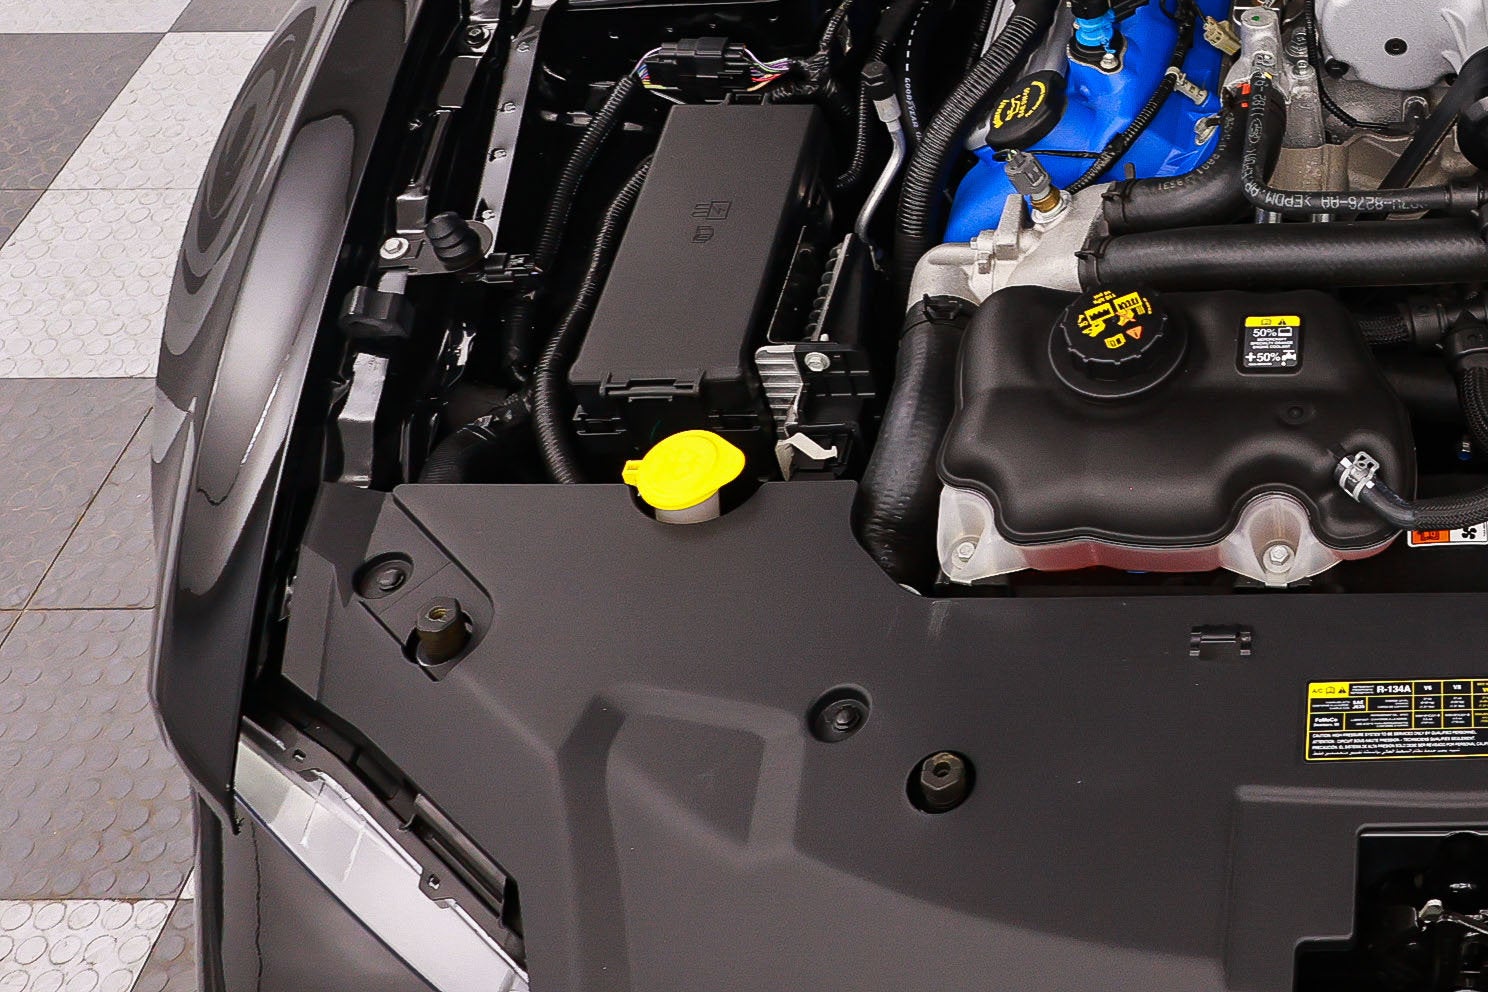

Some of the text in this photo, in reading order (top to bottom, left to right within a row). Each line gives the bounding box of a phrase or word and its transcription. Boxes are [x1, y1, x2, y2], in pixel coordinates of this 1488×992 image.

[904, 77, 919, 128] GOODYEAR
[1252, 328, 1278, 337] 50%
[1376, 685, 1412, 694] R-134A
